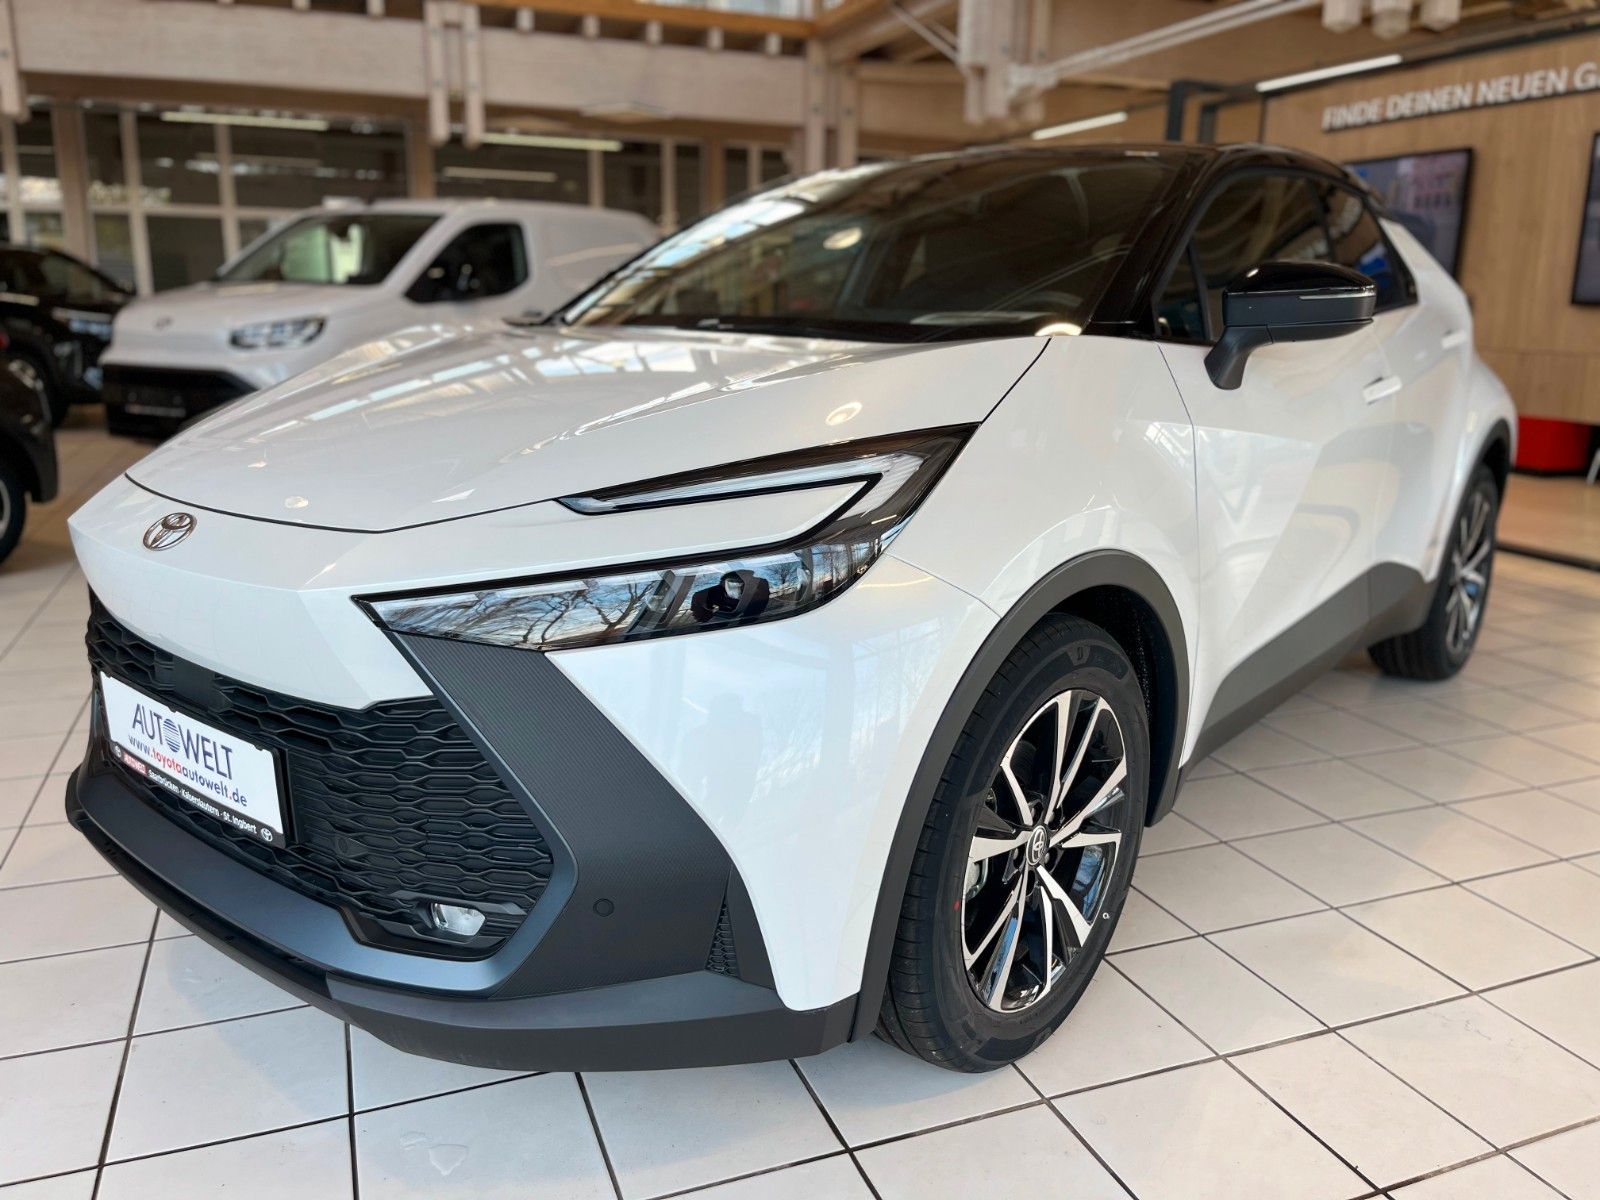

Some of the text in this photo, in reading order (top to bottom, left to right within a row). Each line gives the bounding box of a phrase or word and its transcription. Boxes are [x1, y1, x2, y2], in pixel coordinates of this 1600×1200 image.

[1322, 61, 1600, 131] FINDE DEINEN NEUEN G
[128, 733, 248, 807] www.toyotaautowelt.de
[132, 703, 233, 780] AUTOWELT
[232, 814, 257, 834] Ingbert
